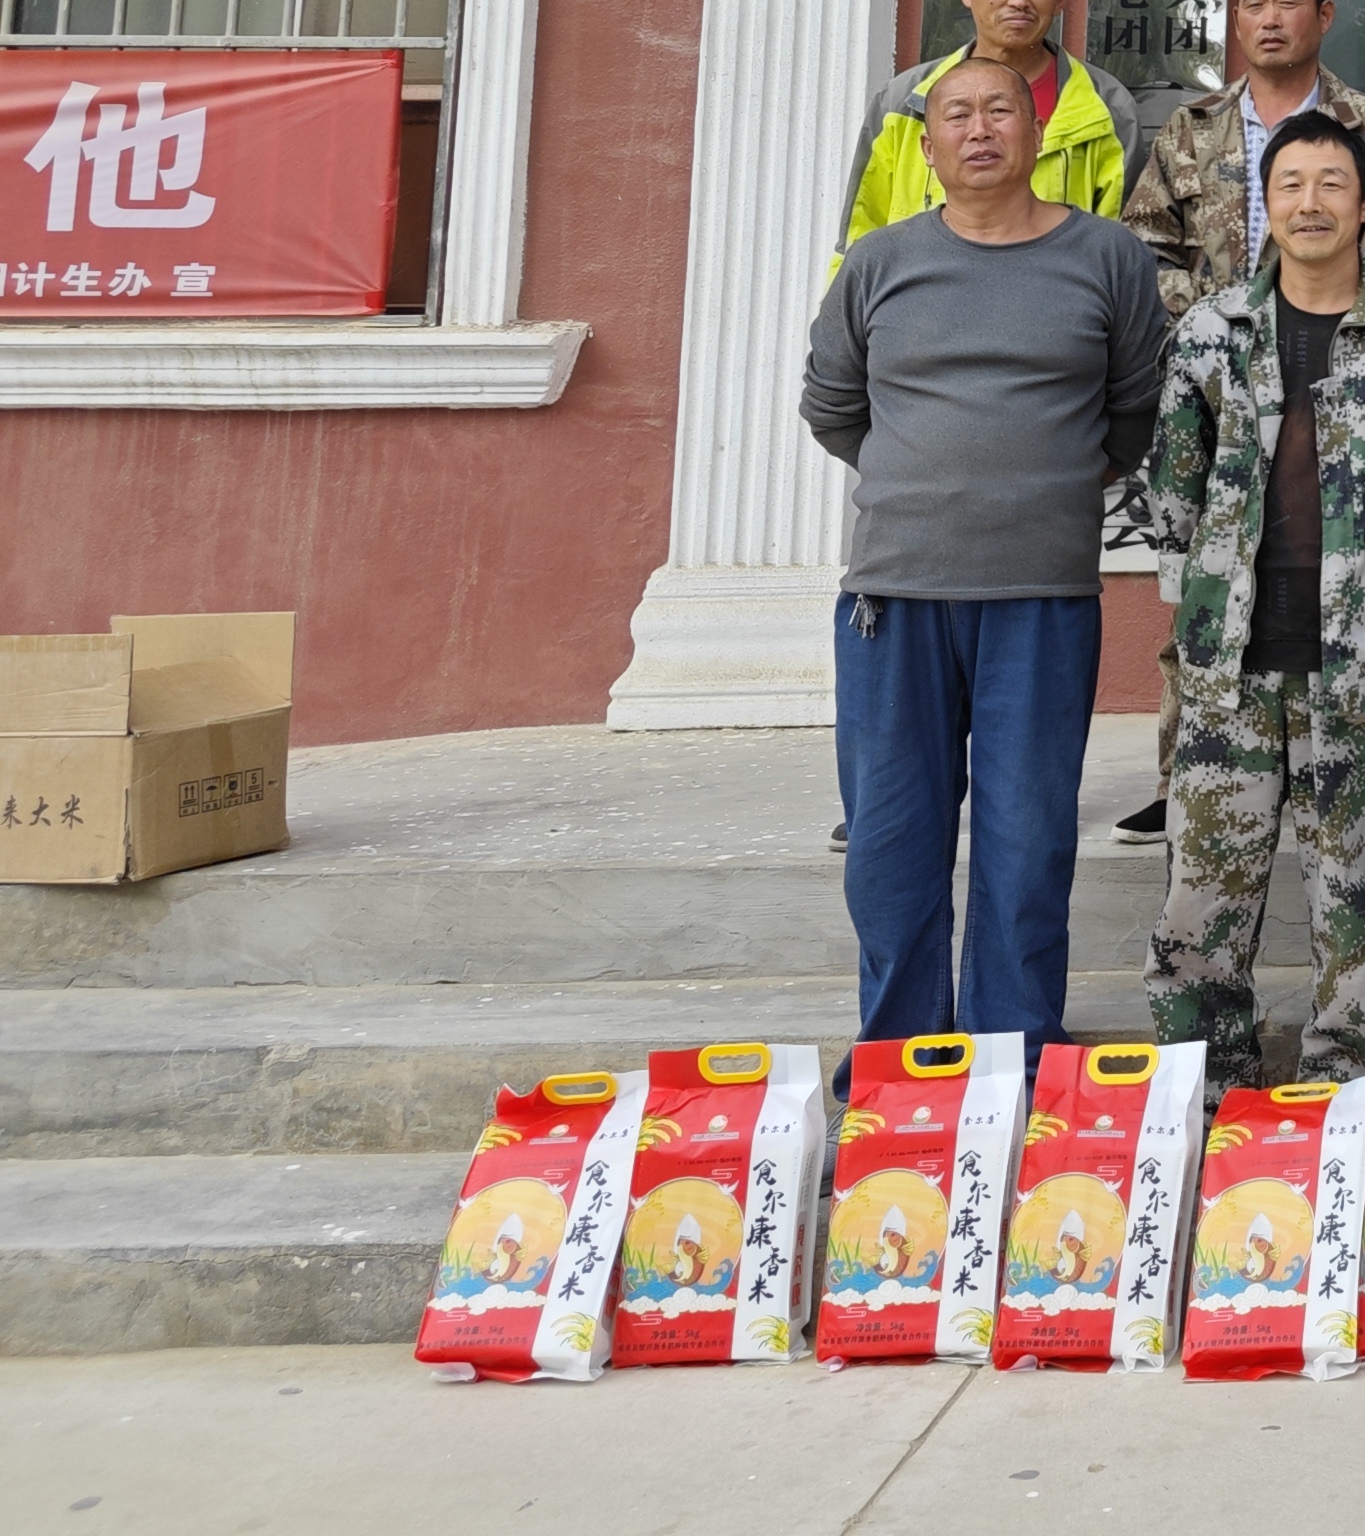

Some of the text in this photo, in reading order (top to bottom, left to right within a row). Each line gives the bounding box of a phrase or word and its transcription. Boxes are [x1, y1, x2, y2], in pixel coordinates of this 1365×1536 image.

[23, 80, 217, 232] 他
[169, 262, 217, 297] 宣
[558, 1160, 613, 1300] 食尔康香米
[746, 1160, 788, 1304] 食尔康香米
[951, 1151, 992, 1296] 食尔康香米
[1128, 1158, 1170, 1304] 食尔康香米
[1317, 1159, 1357, 1299] 食尔康香米
